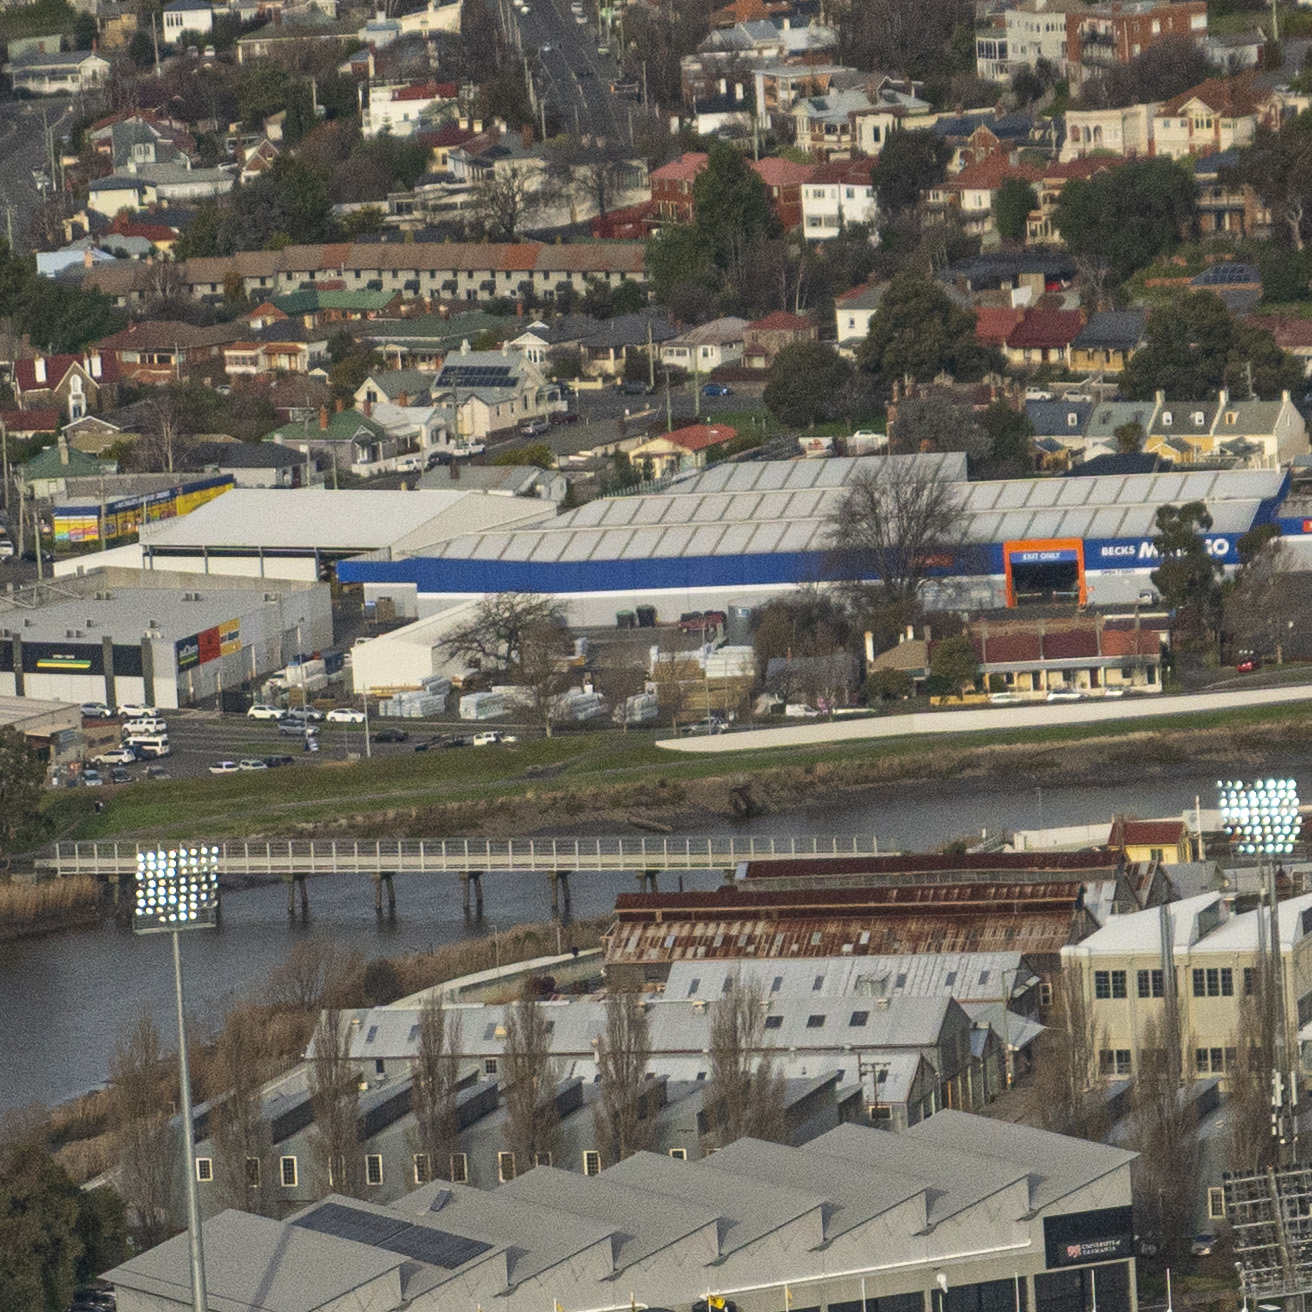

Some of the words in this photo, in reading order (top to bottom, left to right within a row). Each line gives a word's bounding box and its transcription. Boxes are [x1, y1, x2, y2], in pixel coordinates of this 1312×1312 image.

[1022, 552, 1039, 560] EXIT
[1040, 551, 1061, 560] ONLY
[1101, 546, 1135, 557] BECKS
